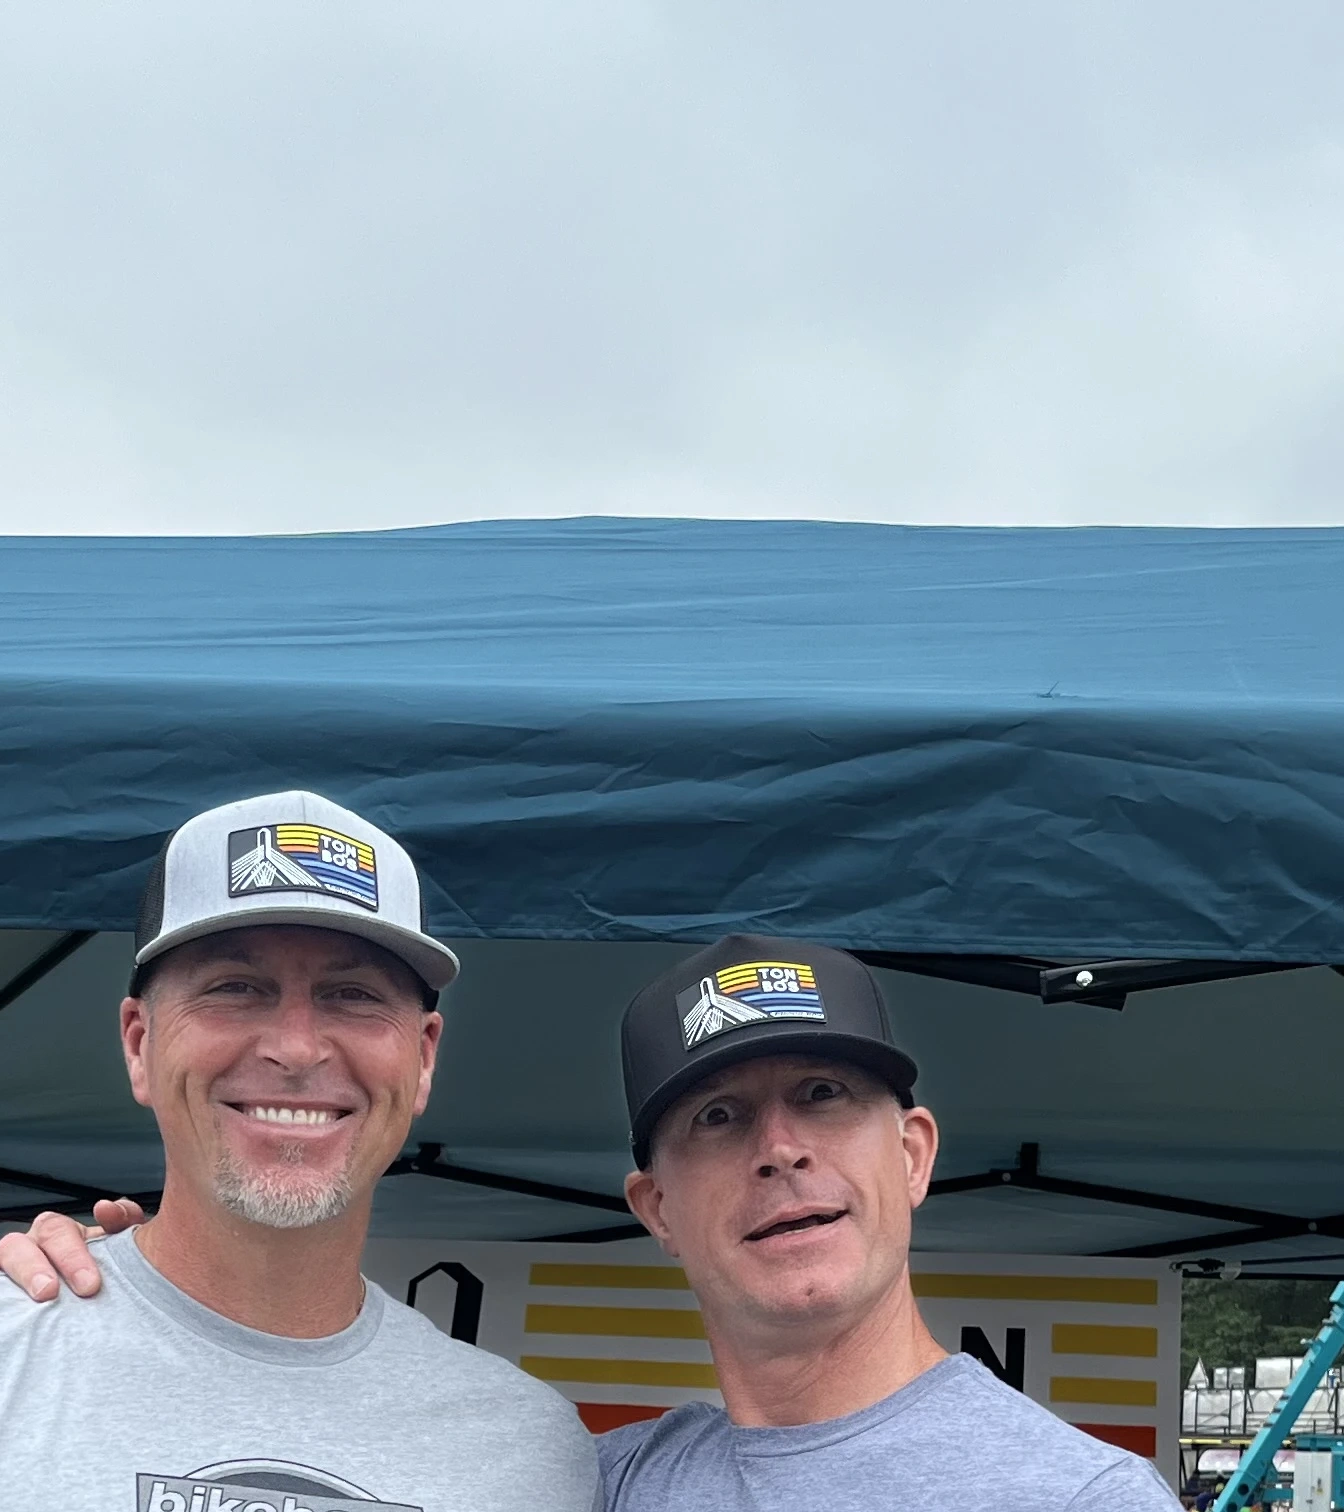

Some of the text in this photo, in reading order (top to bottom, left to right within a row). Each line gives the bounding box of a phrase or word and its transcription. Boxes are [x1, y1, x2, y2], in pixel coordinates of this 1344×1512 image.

[320, 834, 357, 858] TON
[321, 850, 358, 871] BOS
[757, 967, 796, 981] TON
[761, 980, 800, 993] BOS
